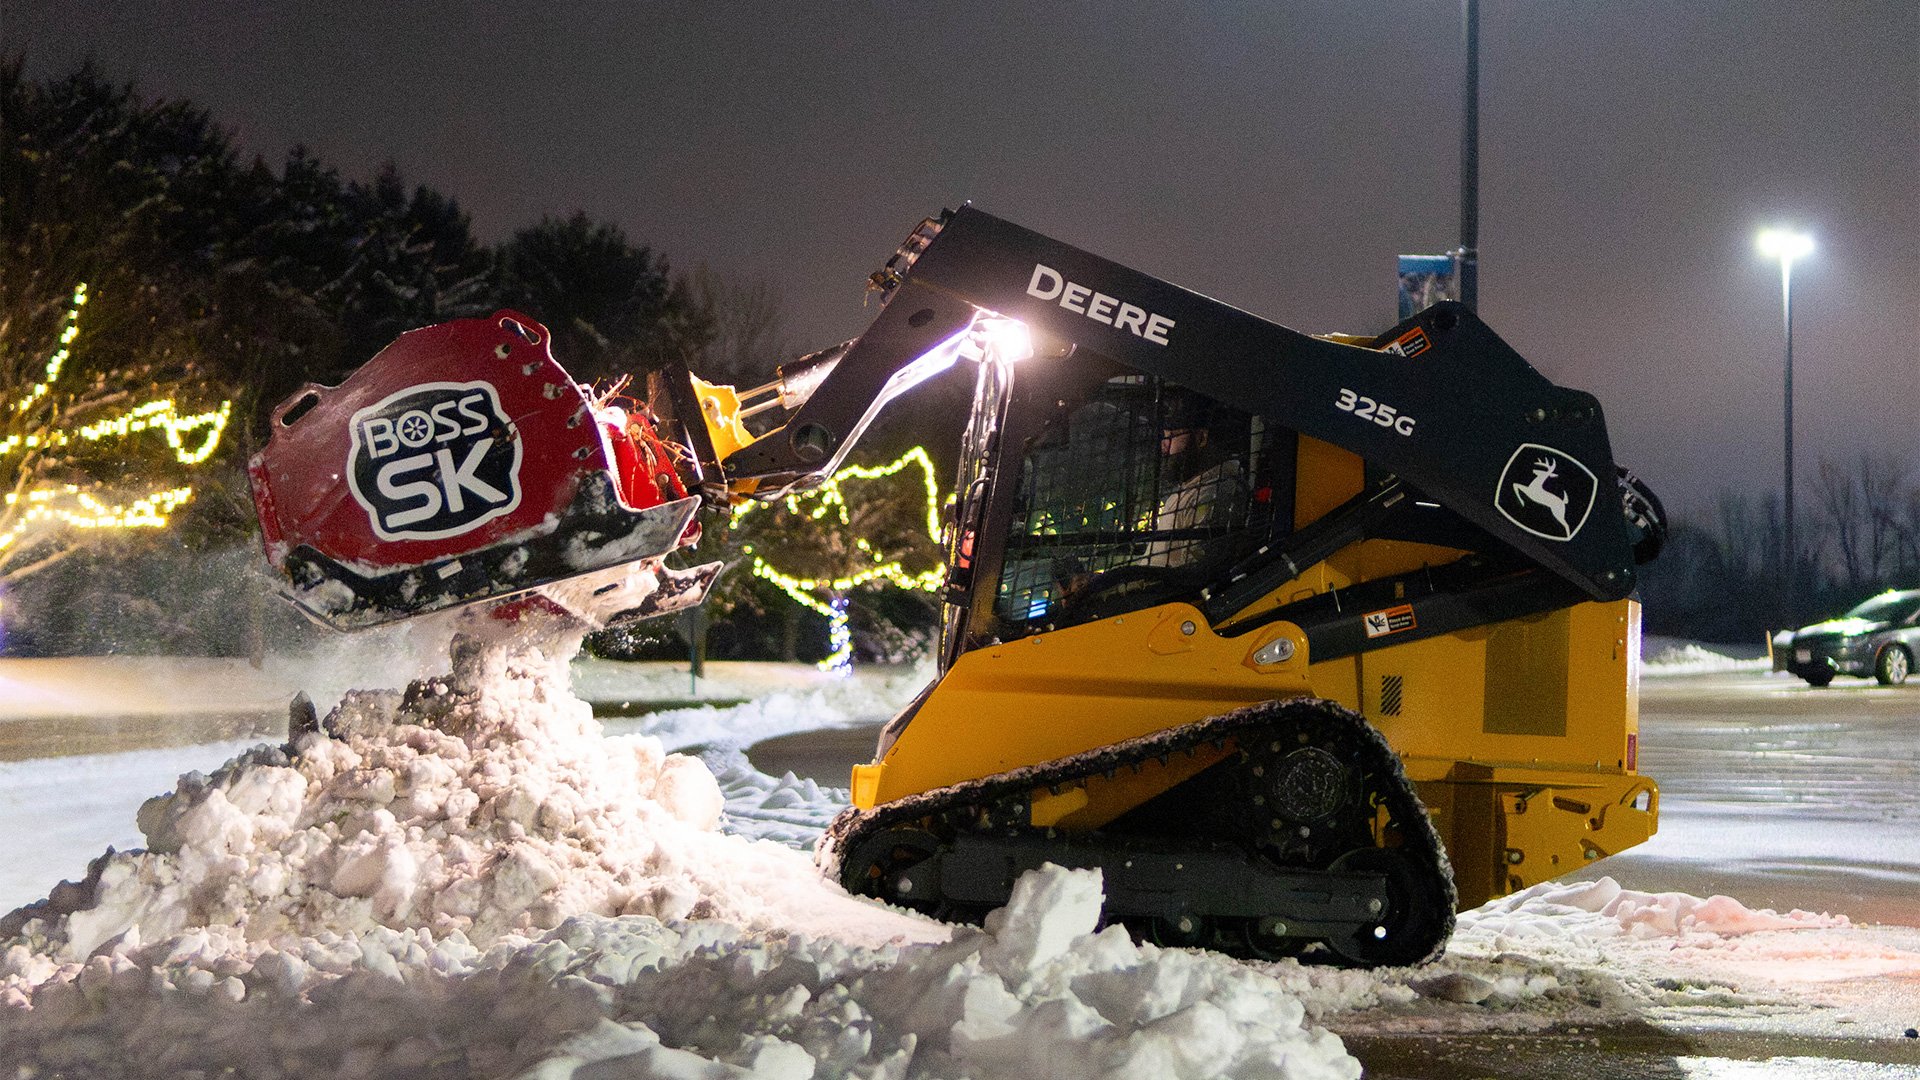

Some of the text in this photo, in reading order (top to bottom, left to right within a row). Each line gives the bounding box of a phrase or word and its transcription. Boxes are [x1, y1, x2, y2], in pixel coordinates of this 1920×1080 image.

[1026, 263, 1176, 346] DEERE
[365, 394, 488, 459] BOSS
[1335, 388, 1416, 437] 325G
[377, 438, 508, 528] SK
